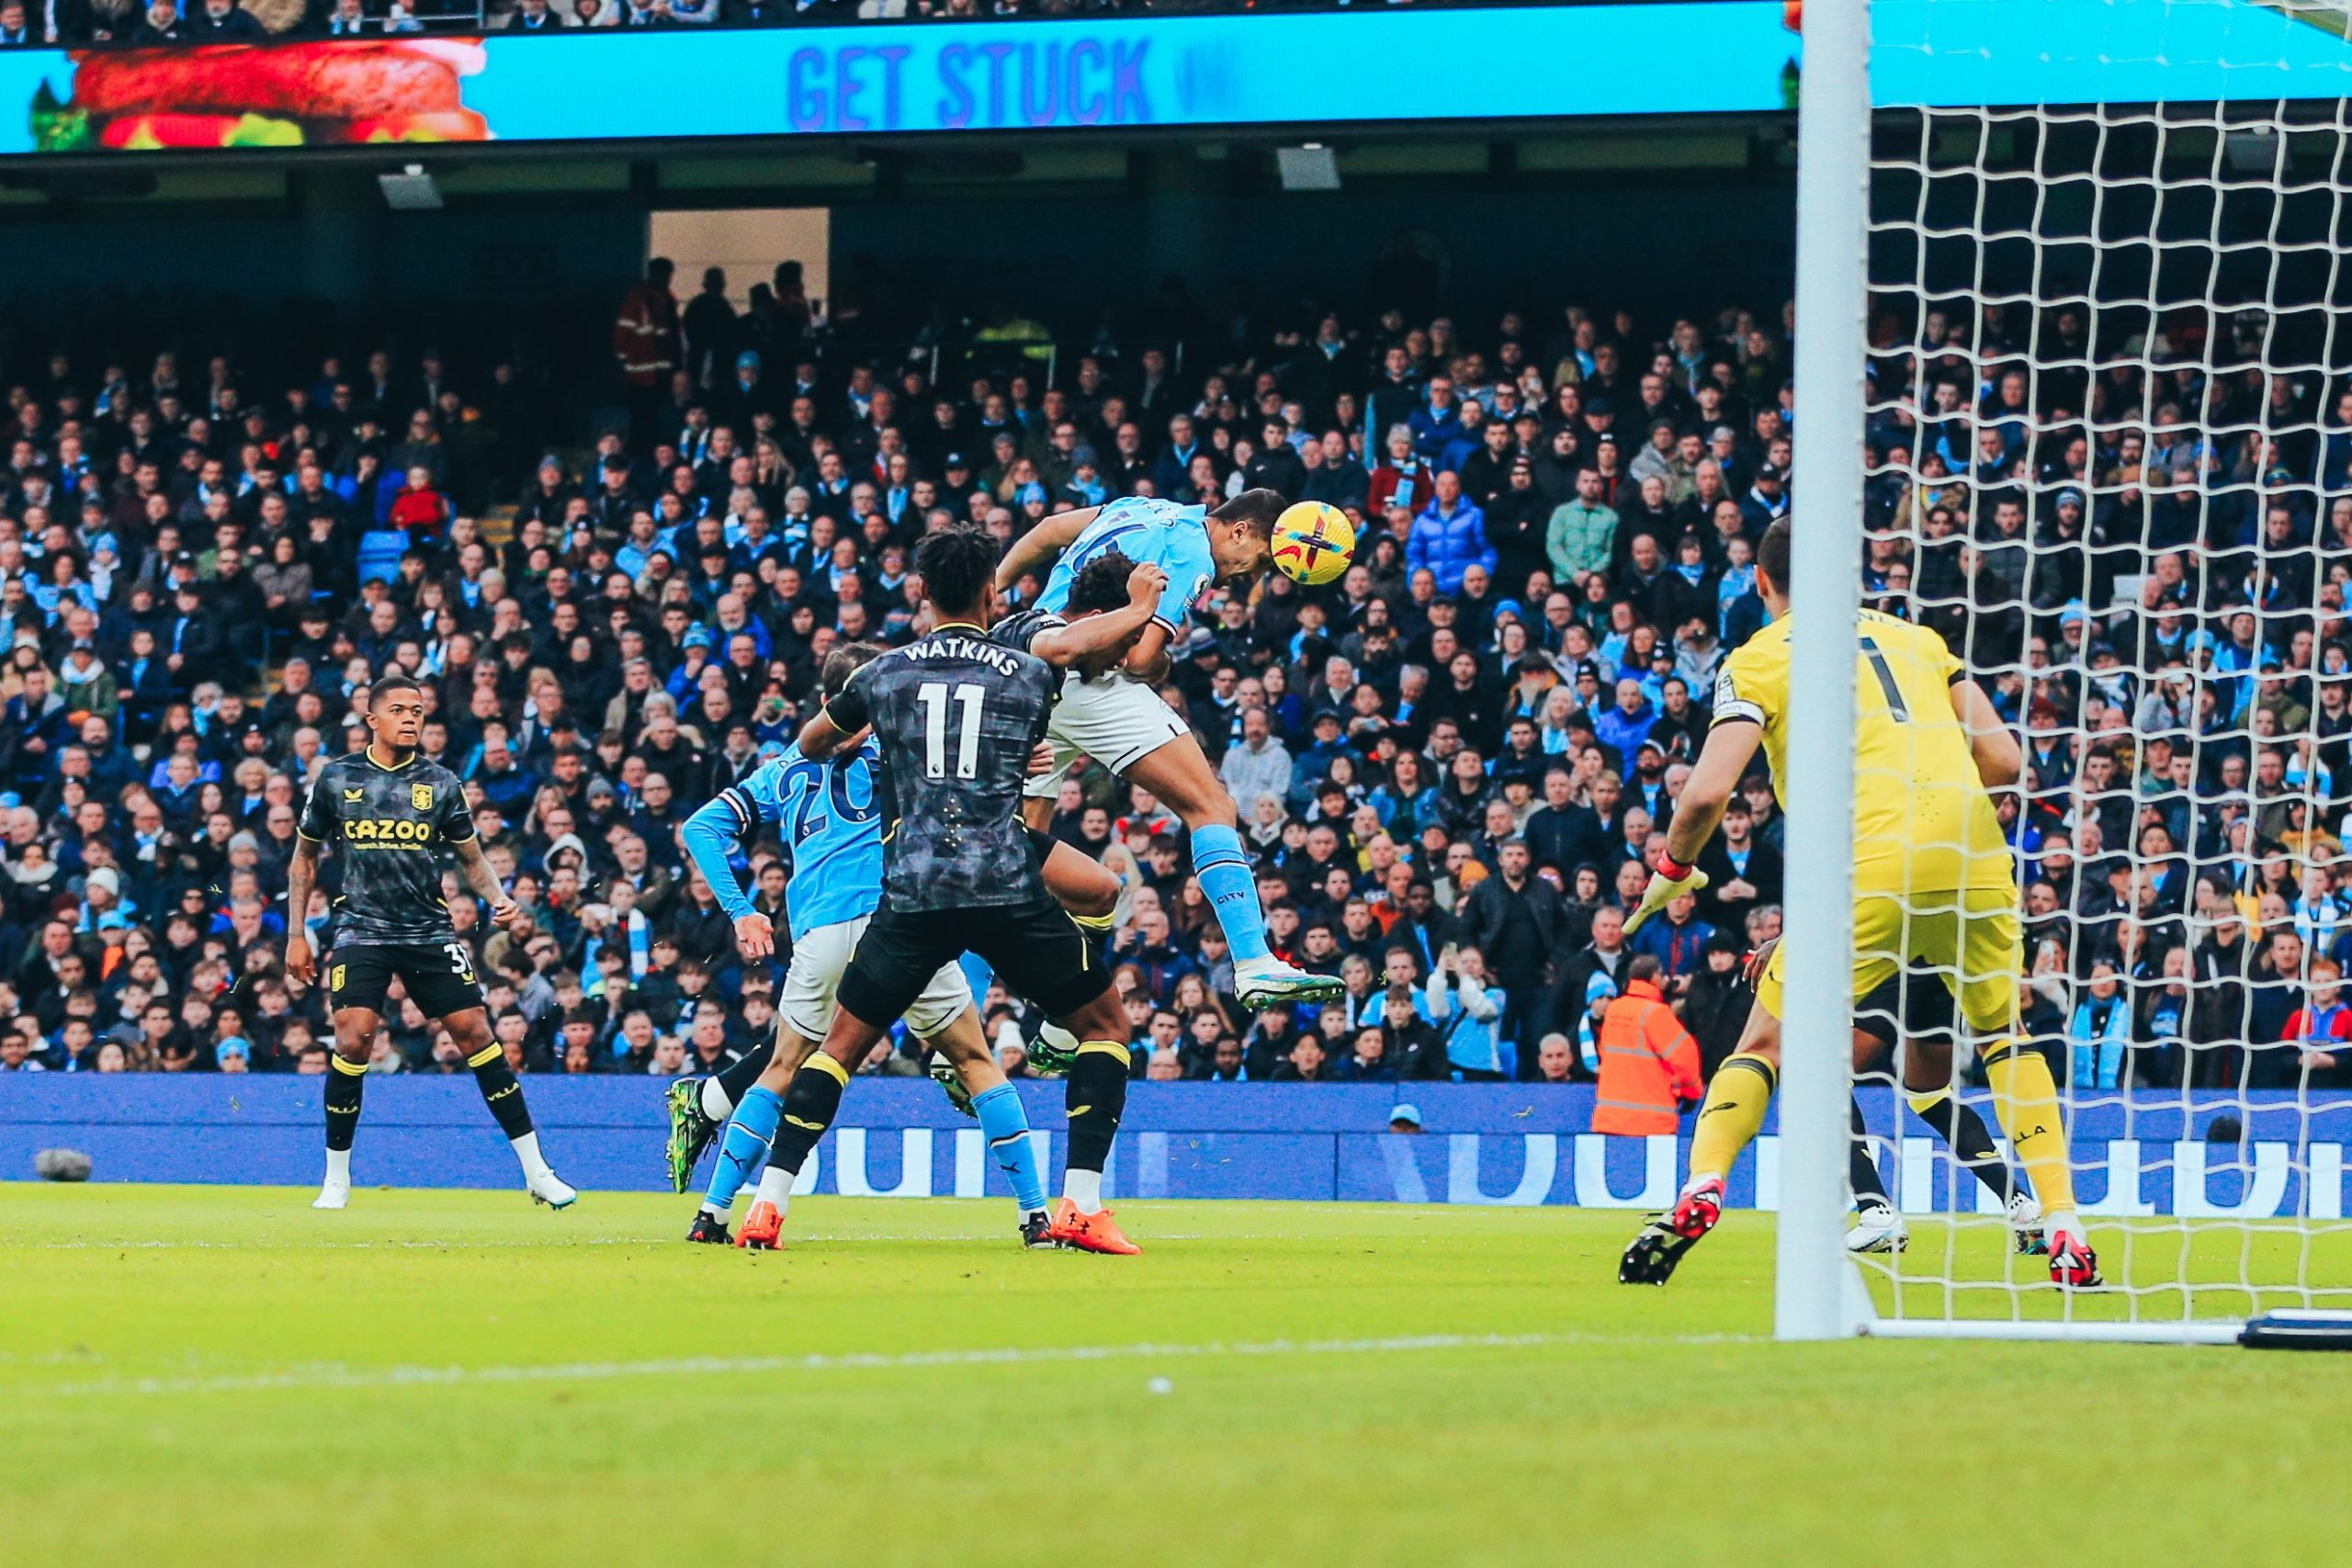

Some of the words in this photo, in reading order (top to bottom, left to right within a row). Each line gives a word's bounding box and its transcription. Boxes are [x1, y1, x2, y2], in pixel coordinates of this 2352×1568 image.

[787, 44, 911, 131] GET
[936, 39, 1151, 129] STUCK
[903, 638, 1020, 677] WATKINS
[917, 682, 986, 780] 11
[778, 745, 880, 848] 20
[345, 819, 430, 841] CAZOO
[1216, 891, 1245, 905] CITY
[487, 1082, 520, 1101] VILLA
